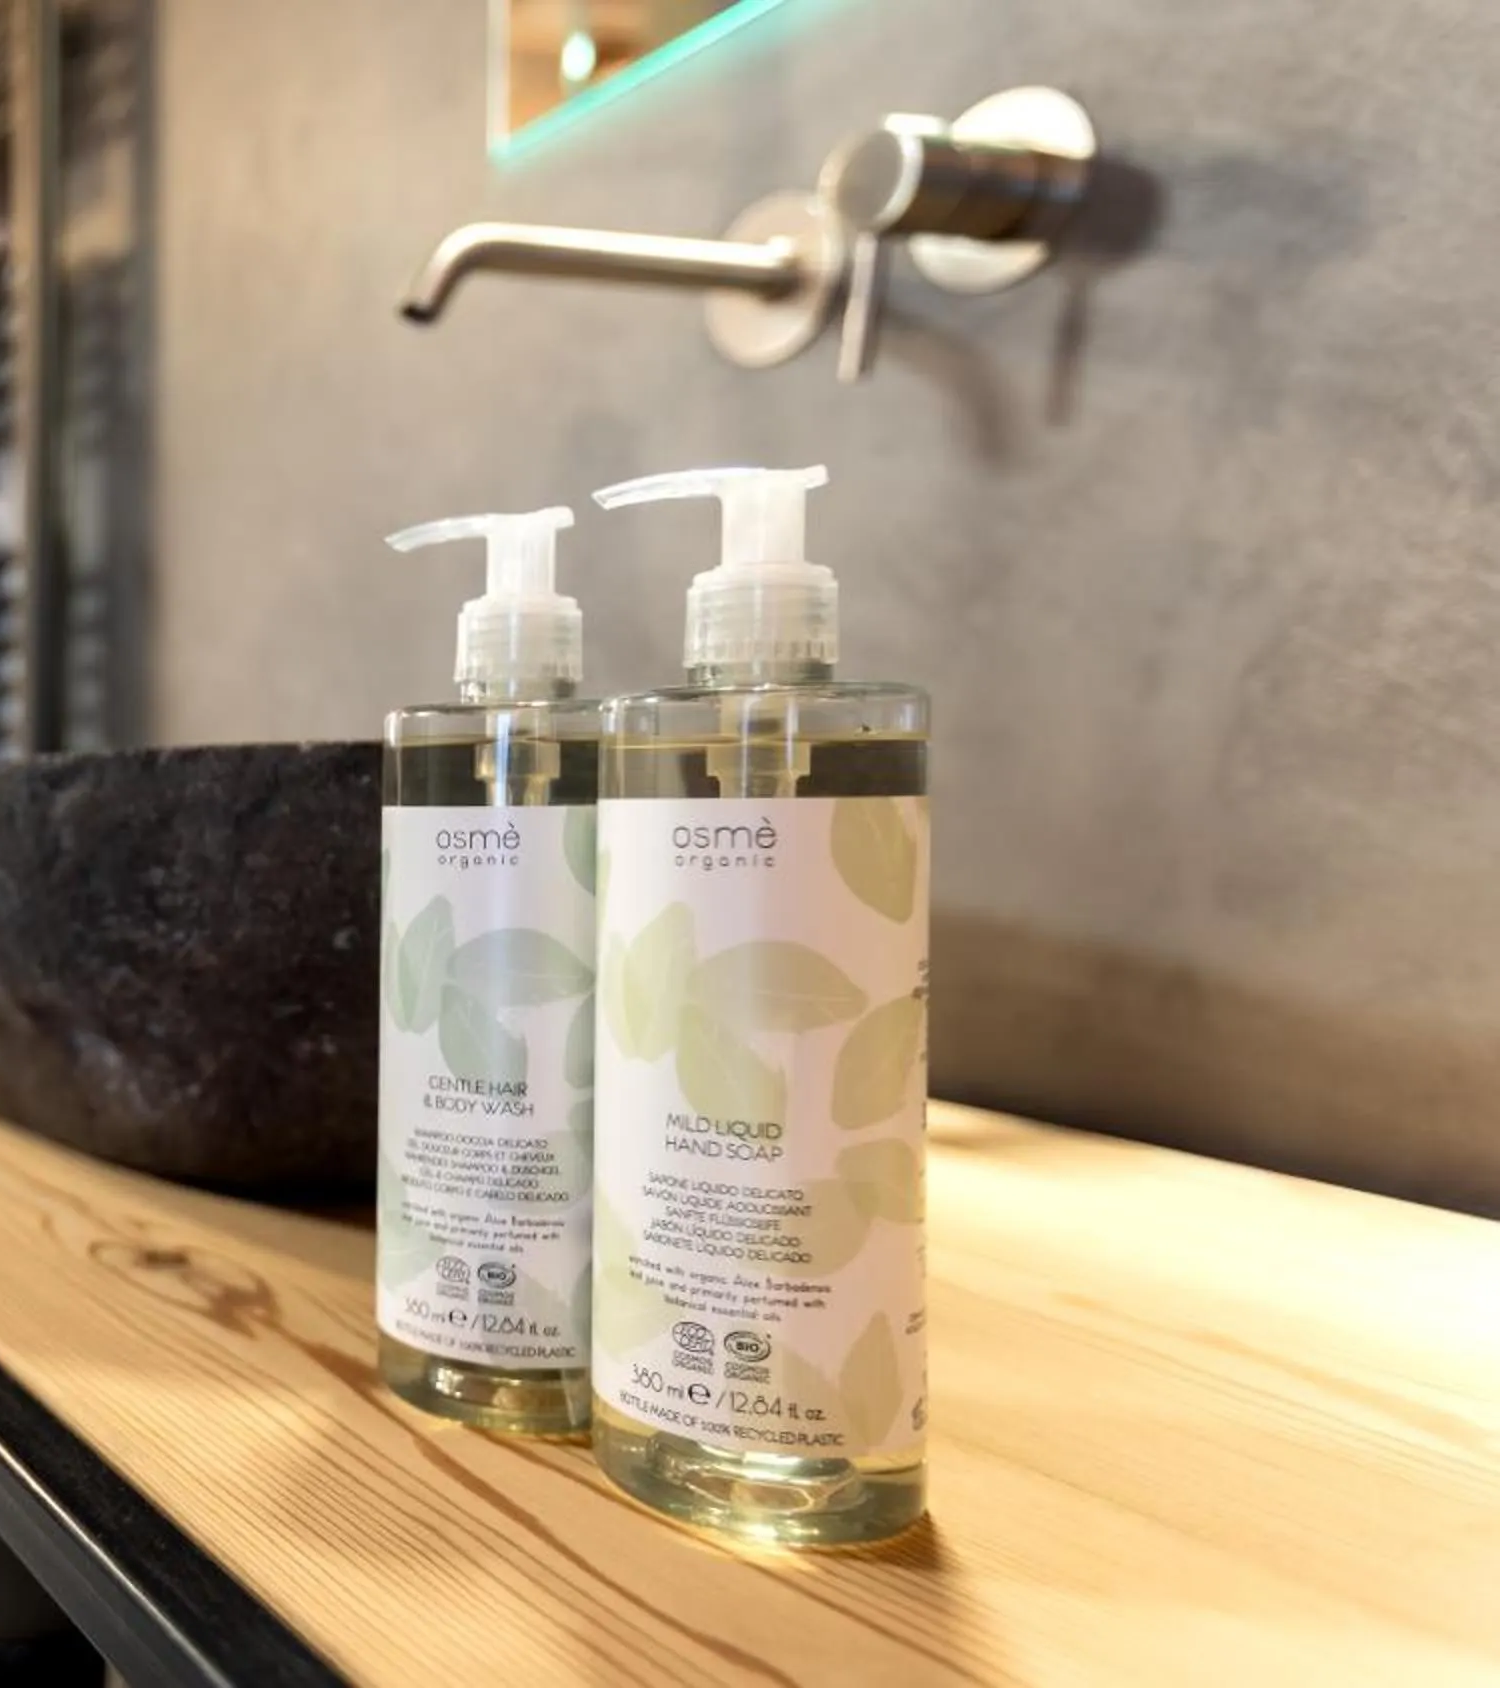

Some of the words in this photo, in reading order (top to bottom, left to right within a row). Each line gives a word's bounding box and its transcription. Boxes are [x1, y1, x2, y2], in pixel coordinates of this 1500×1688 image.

[436, 822, 521, 851] osmè
[673, 817, 777, 851] osmè
[438, 854, 520, 869] organic
[675, 853, 777, 871] organic
[429, 1076, 485, 1094] GENTLE
[489, 1080, 528, 1097] HAIR
[435, 1095, 477, 1113] BODY
[481, 1100, 534, 1117] WASH
[666, 1113, 710, 1133] MILD
[715, 1119, 783, 1140] LIQUID
[498, 1137, 548, 1149] DELICATO
[665, 1135, 722, 1158] HAND
[727, 1143, 784, 1162] SOAP
[518, 1191, 569, 1202] DELICADO
[643, 1185, 679, 1202] SAVON
[680, 1194, 723, 1210] LIQUIDE
[648, 1171, 687, 1190] SAPONE
[742, 1187, 804, 1201] DELICATO
[643, 1230, 694, 1251] SABONETE
[747, 1248, 813, 1263] DELICADO
[735, 1230, 801, 1248] DELICADO
[736, 1341, 760, 1352] BIO
[631, 1364, 663, 1393] 380
[650, 1405, 680, 1426] MADE
[682, 1414, 700, 1428] OF
[733, 1425, 796, 1446] RECYCLED
[796, 1432, 845, 1447] PLASTIC
